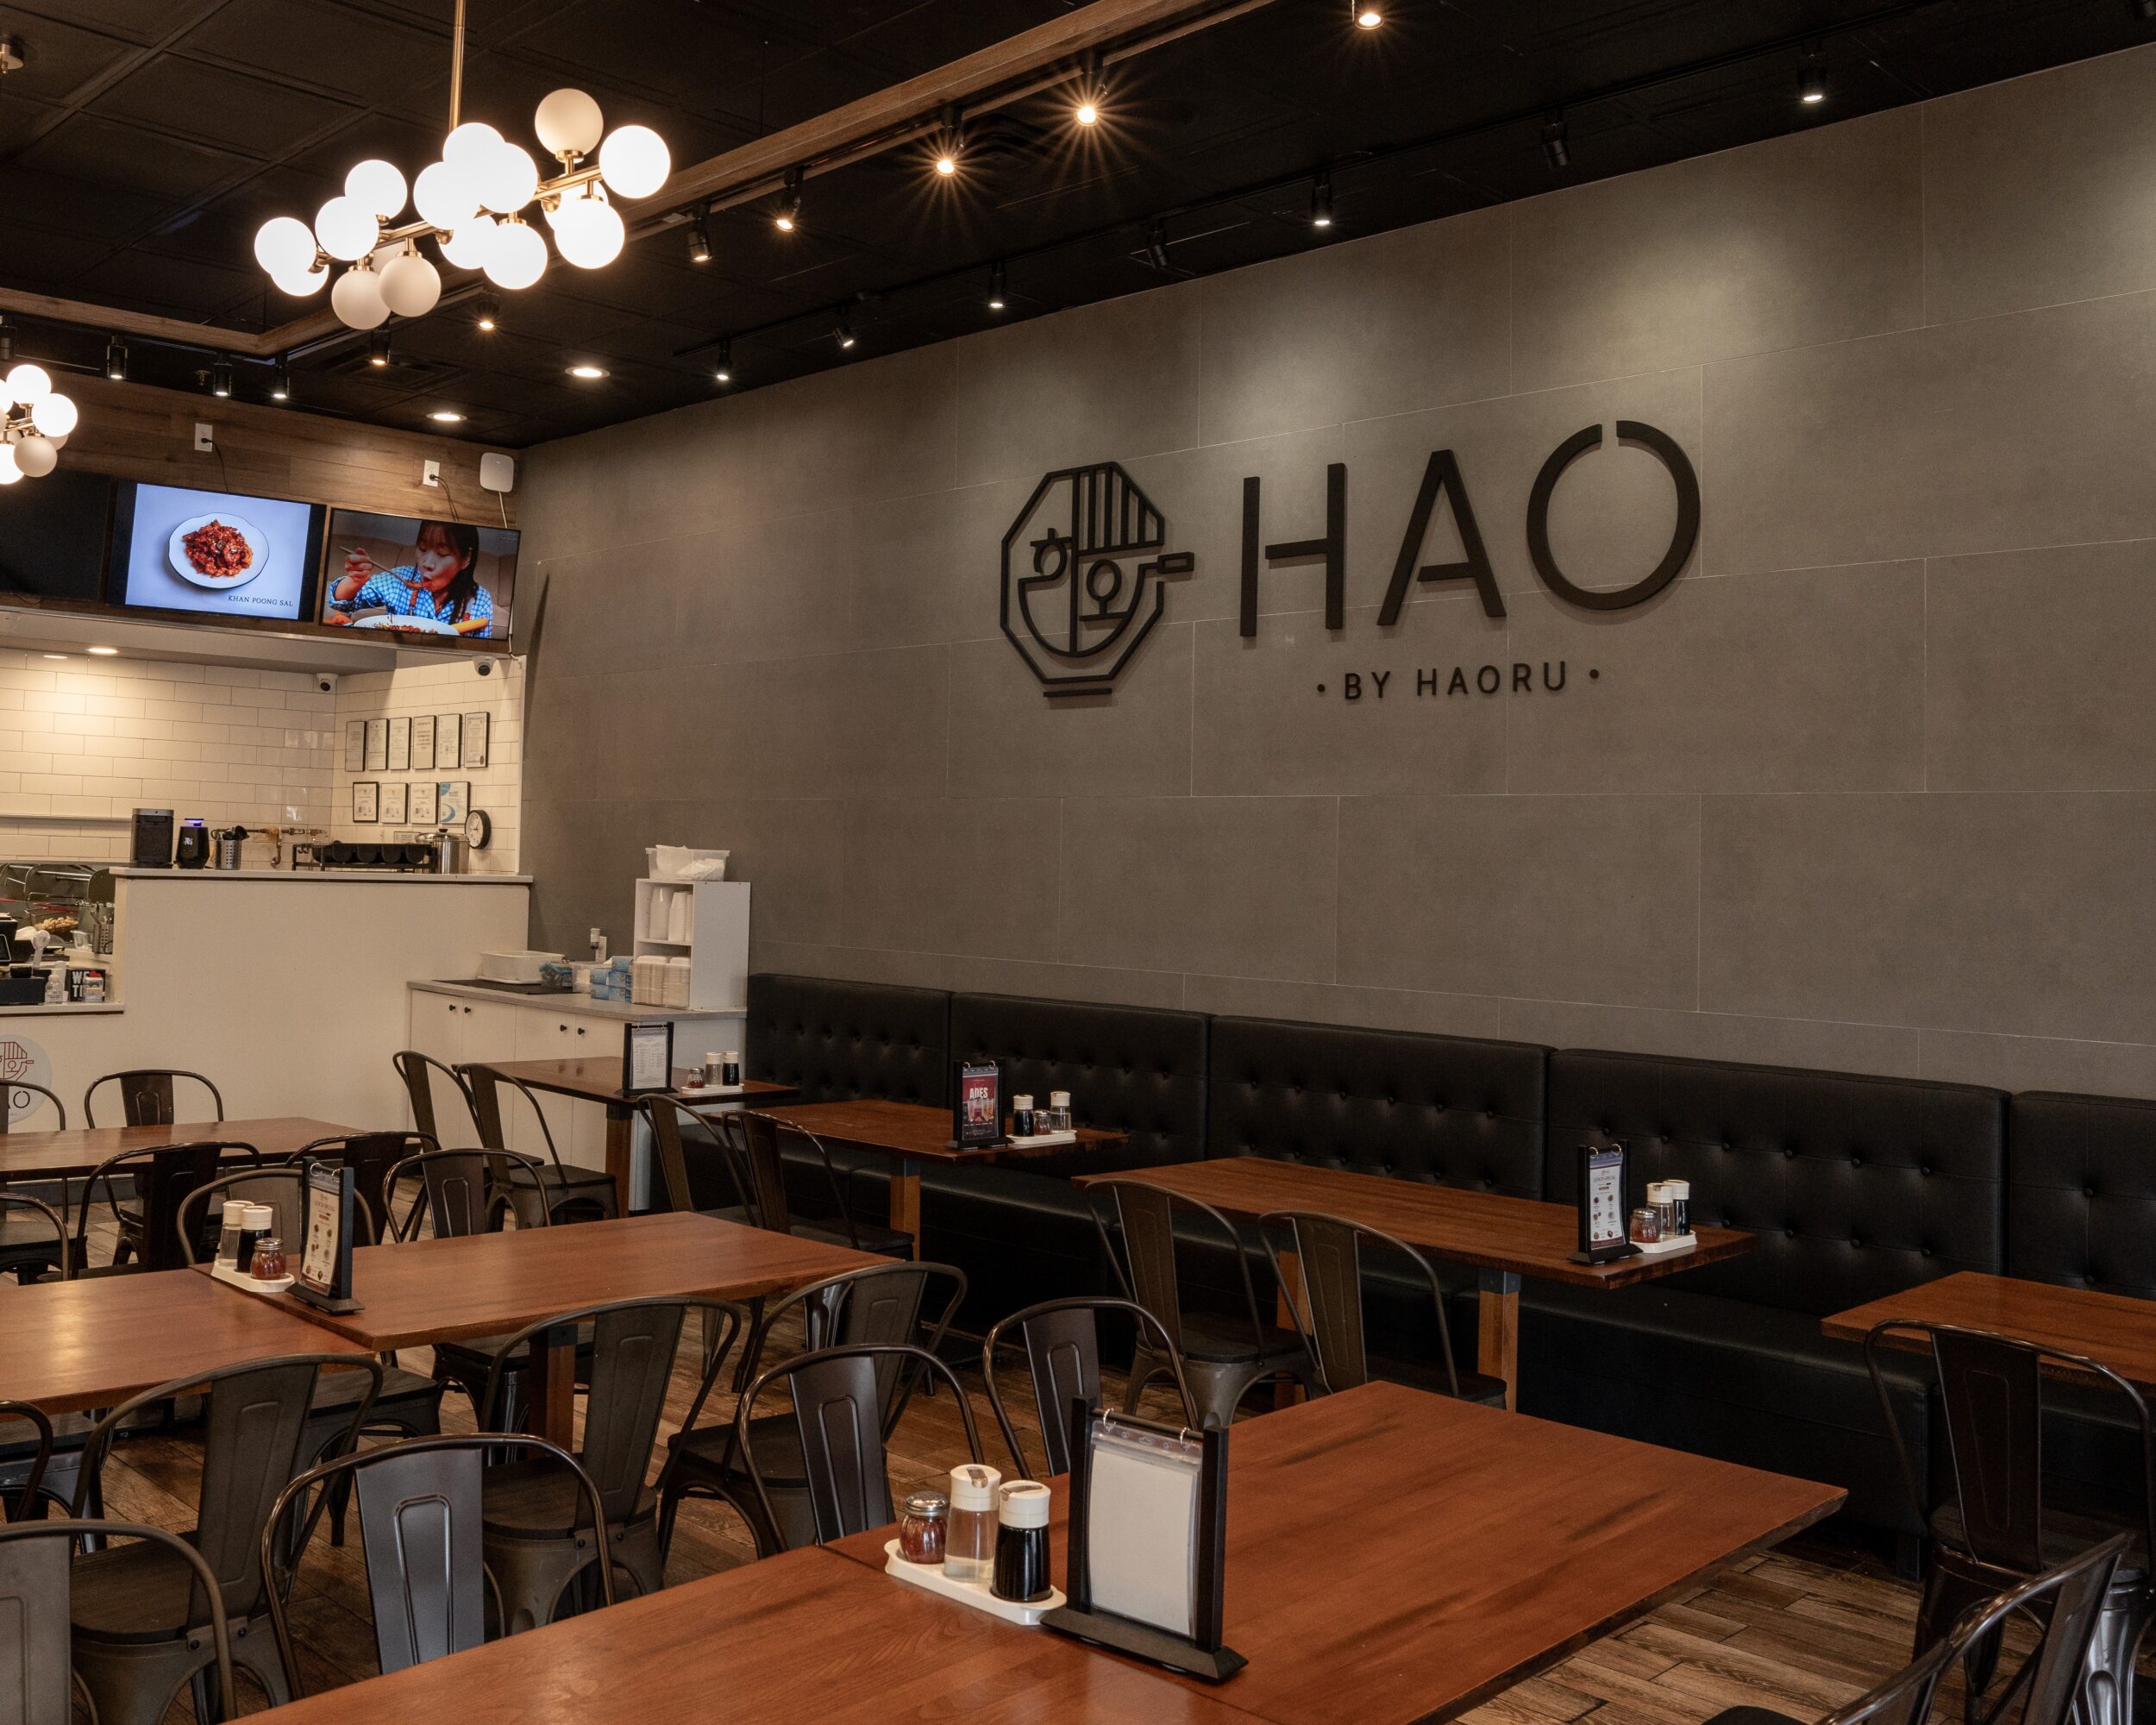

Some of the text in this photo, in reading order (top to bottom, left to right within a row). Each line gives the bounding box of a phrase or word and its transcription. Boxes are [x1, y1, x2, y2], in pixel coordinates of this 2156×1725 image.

[1240, 420, 1701, 637] HAO
[228, 594, 249, 603] KHAN
[252, 597, 278, 605] POONG
[1344, 661, 1565, 699] BY HAORU
